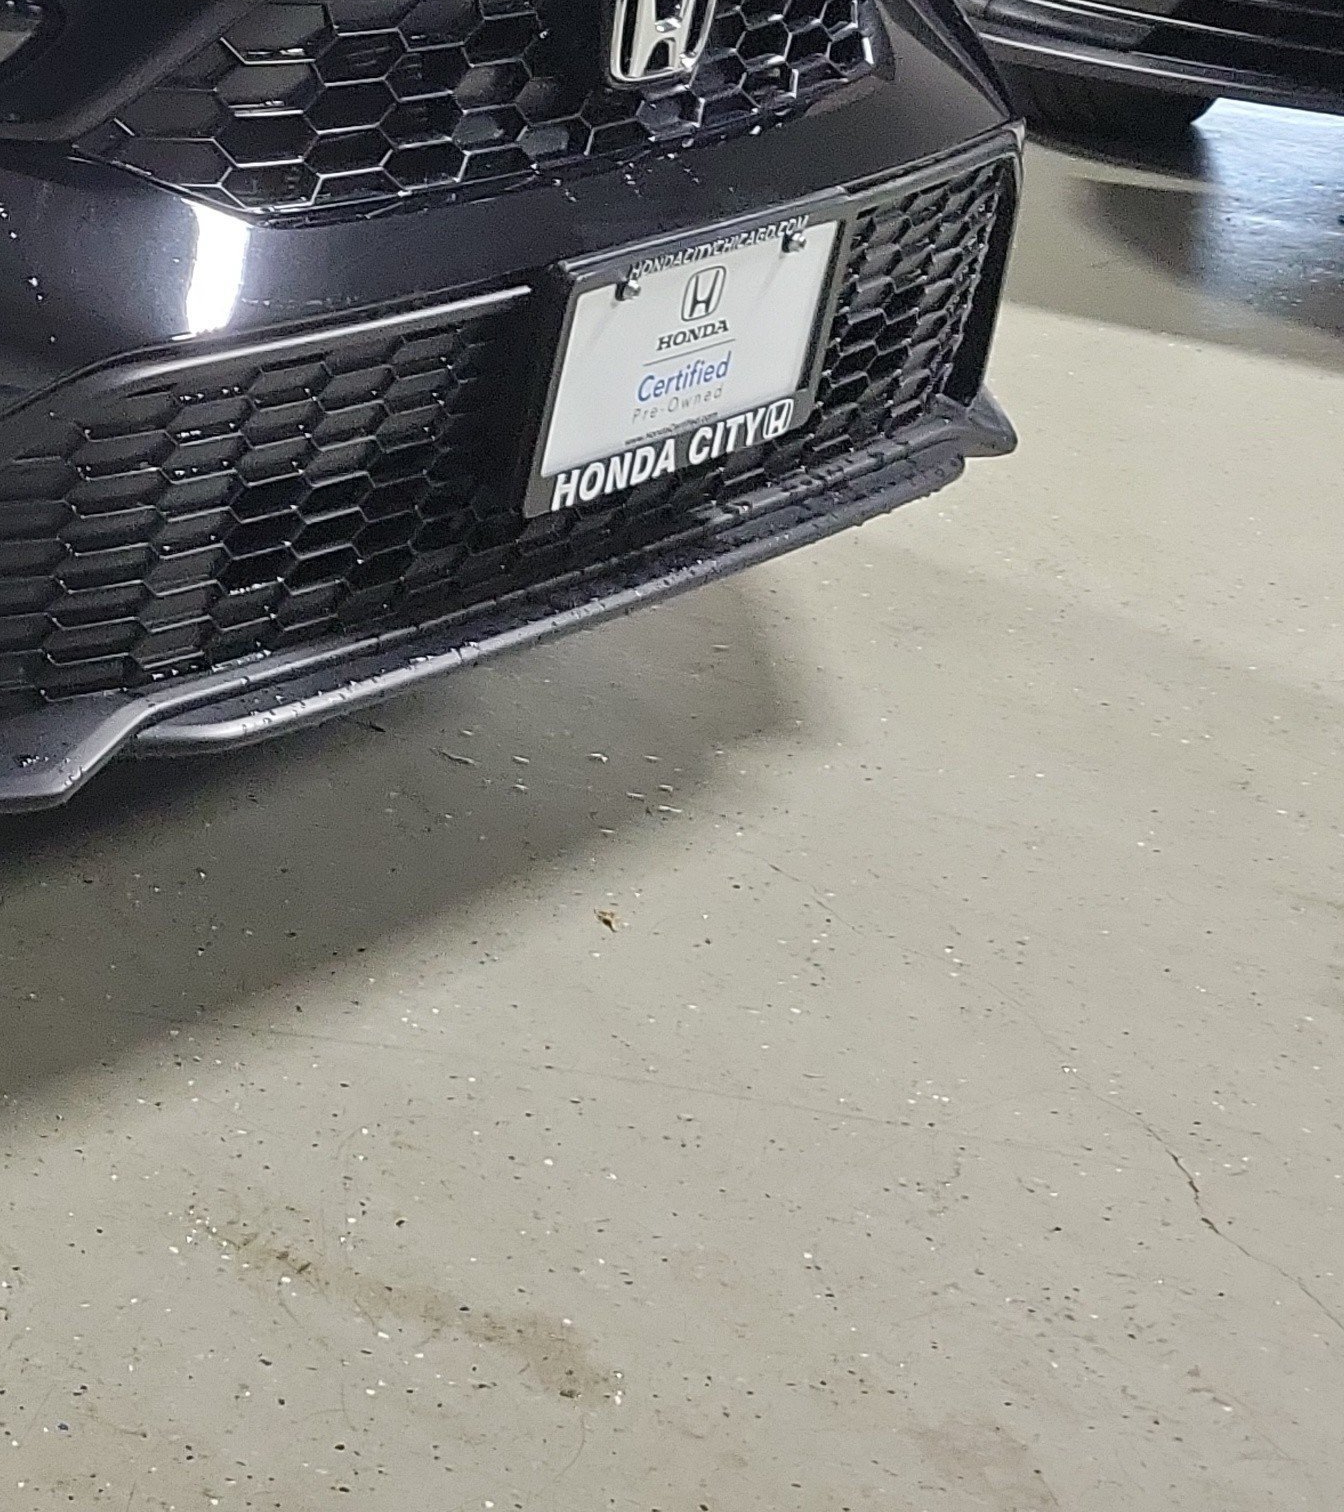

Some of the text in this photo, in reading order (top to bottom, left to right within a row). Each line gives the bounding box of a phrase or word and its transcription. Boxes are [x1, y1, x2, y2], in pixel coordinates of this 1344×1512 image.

[656, 319, 730, 351] HONDA
[638, 350, 732, 402] Certified
[632, 384, 724, 423] Pre-Owned
[551, 439, 676, 512] HONDA
[688, 408, 765, 466] CITY
